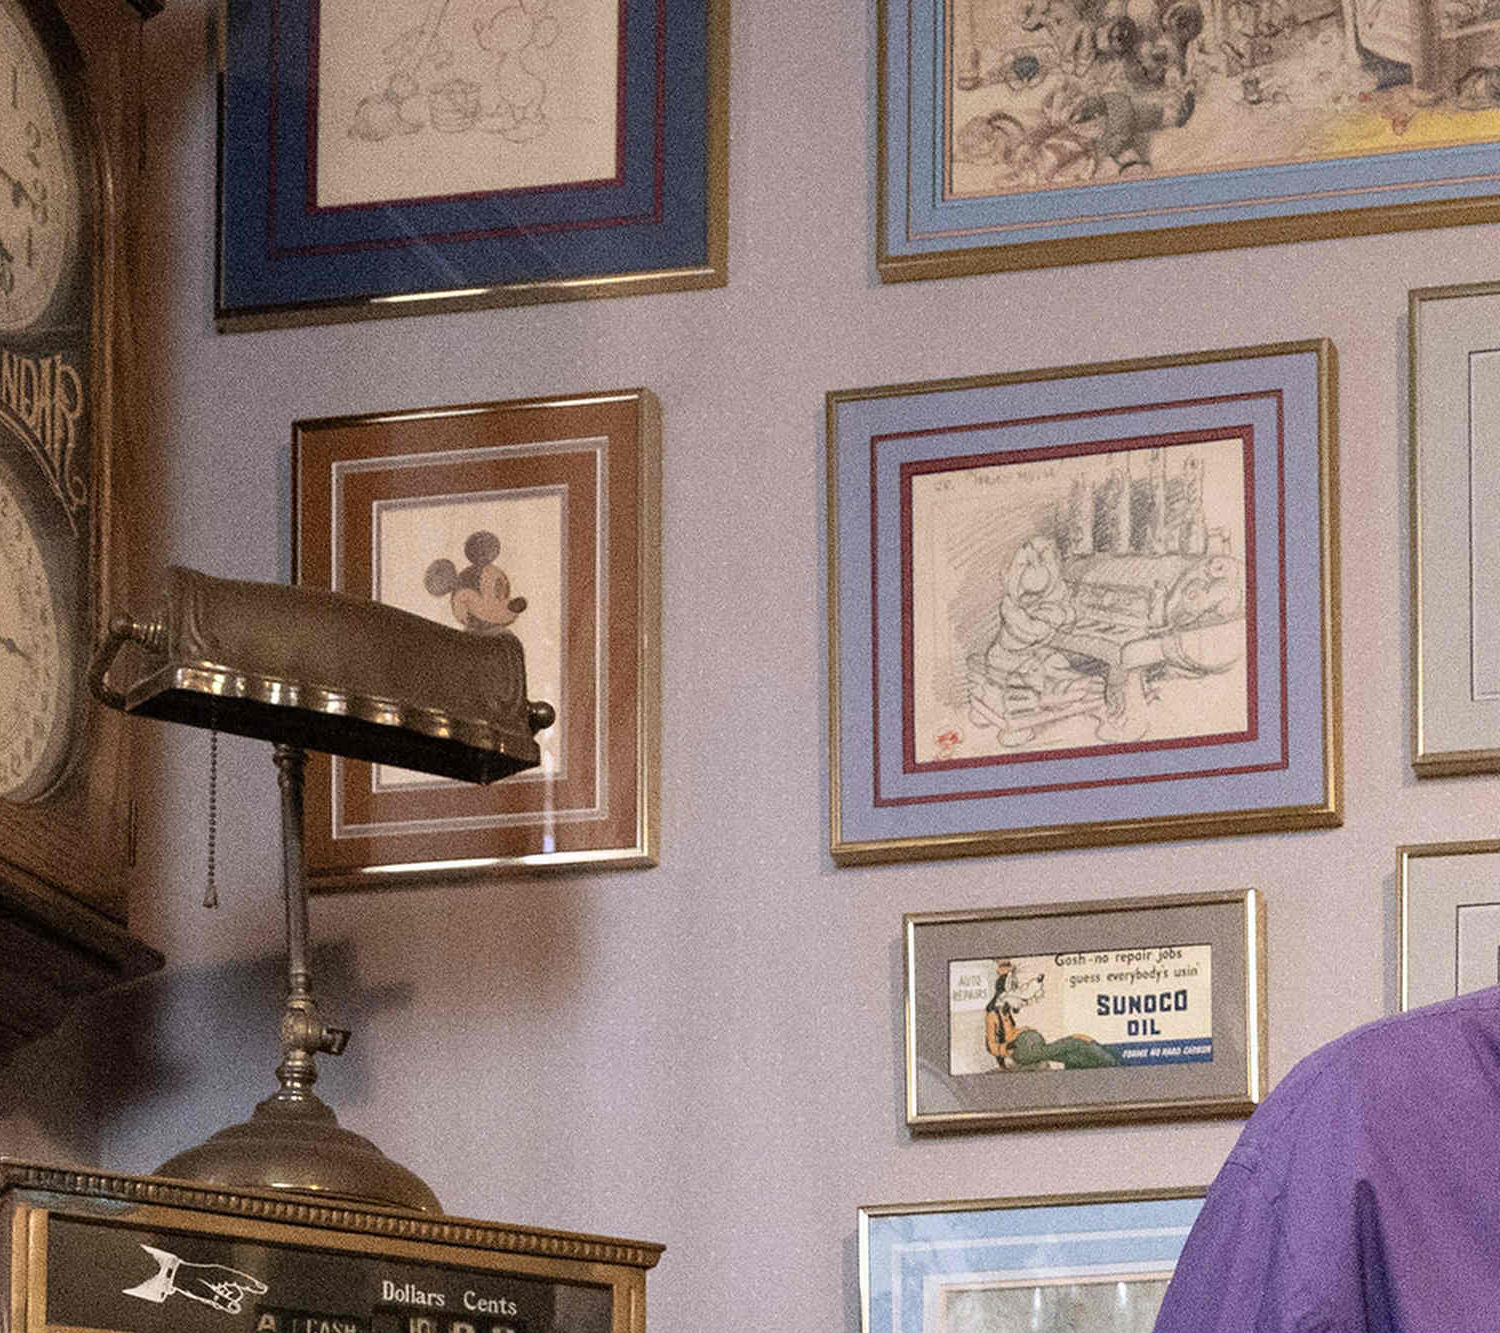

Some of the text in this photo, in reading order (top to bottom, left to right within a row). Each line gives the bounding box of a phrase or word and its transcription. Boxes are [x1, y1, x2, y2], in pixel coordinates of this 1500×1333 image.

[1115, 949, 1151, 965] repair
[1158, 948, 1183, 963] jobs
[1106, 965, 1169, 985] everybody's
[1096, 989, 1188, 1016] SUNOCO
[1127, 1018, 1161, 1036] OIL
[382, 1280, 517, 1316] Dollars Cents
[257, 1314, 276, 1332] A
